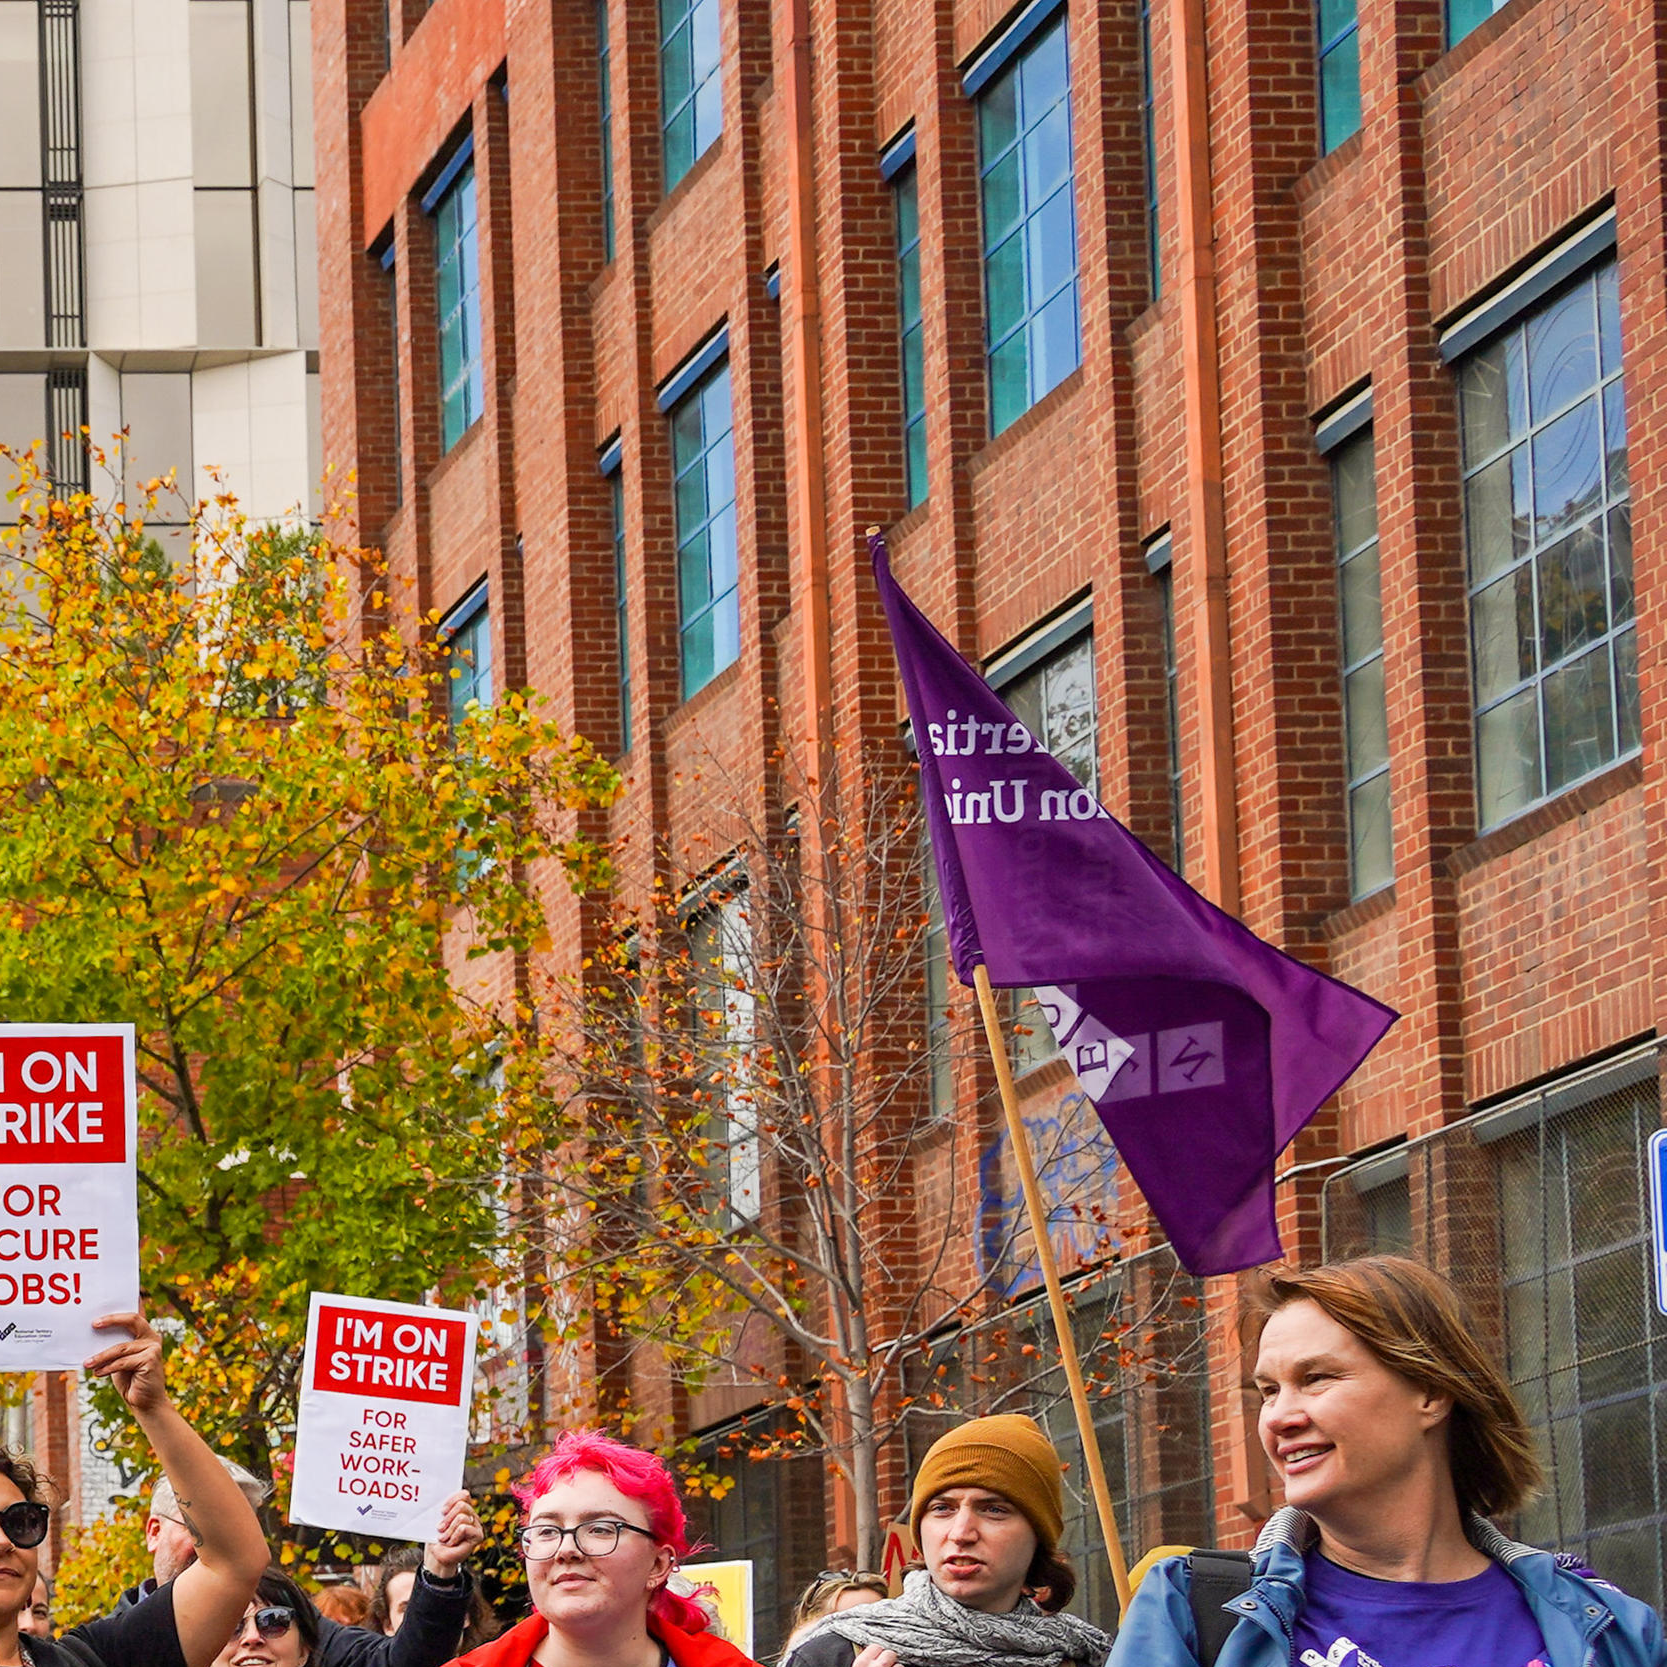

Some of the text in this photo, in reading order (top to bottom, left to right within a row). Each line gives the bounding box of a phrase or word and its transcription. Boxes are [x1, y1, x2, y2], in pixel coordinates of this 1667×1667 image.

[22, 1051, 98, 1093] ON
[335, 1317, 447, 1357] I'M ON
[329, 1351, 449, 1392] STRIKE
[362, 1408, 407, 1430] FOR
[349, 1430, 418, 1456] SAFER
[340, 1453, 421, 1477] WORK-
[338, 1475, 419, 1503] LOADS!
